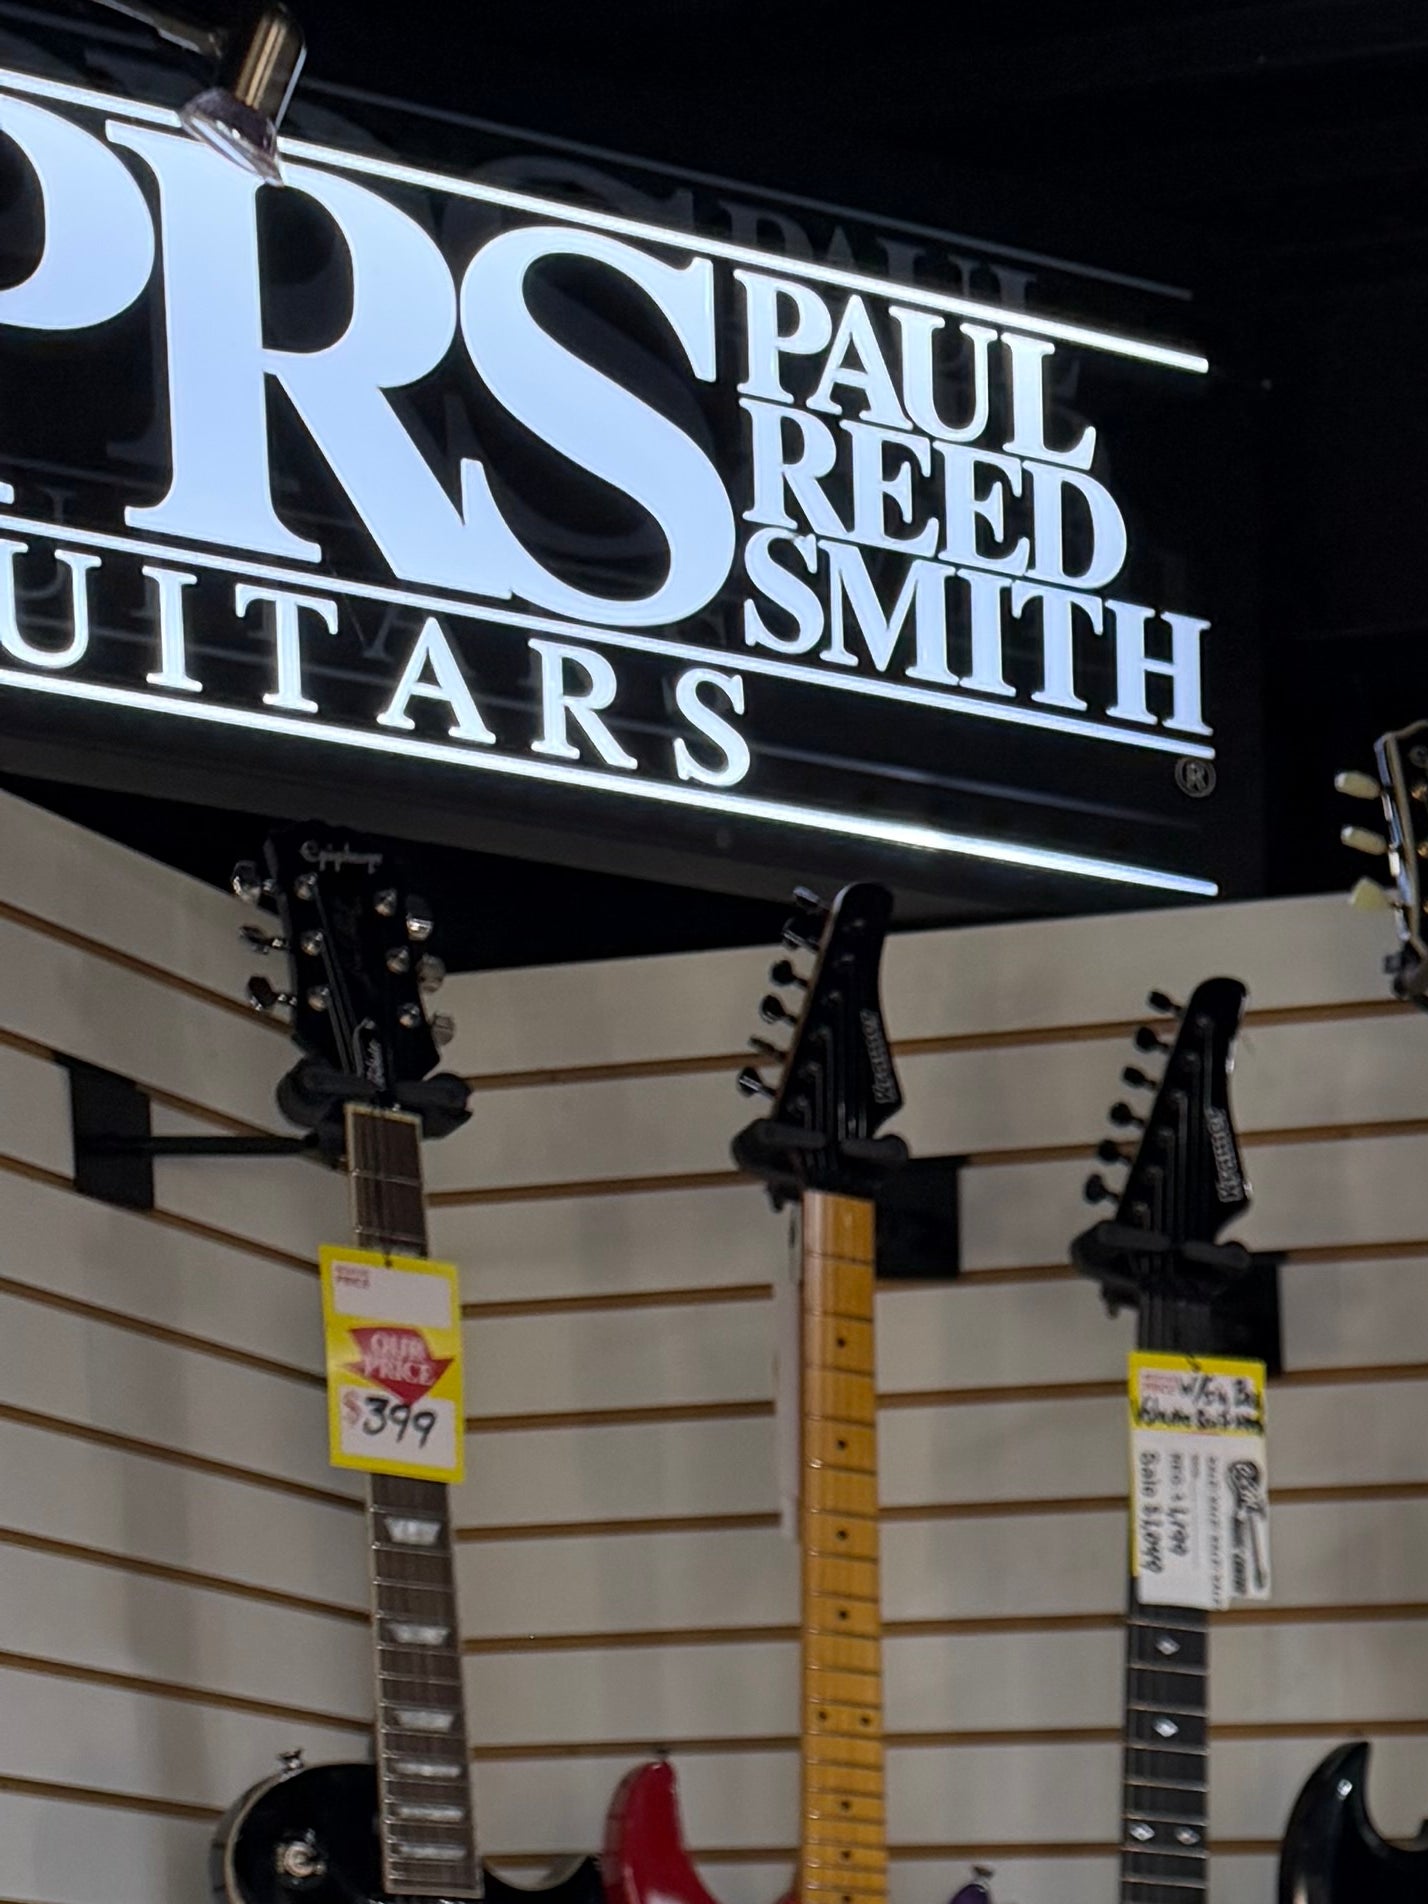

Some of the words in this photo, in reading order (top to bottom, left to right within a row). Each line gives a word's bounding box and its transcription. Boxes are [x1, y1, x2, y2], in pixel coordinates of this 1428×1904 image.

[733, 267, 1097, 469] PAUL
[739, 396, 1128, 591] REED
[0, 541, 752, 788] UITARS
[743, 528, 1214, 737] SMITH
[362, 1353, 434, 1386] PRICE
[370, 1332, 425, 1354] OUR
